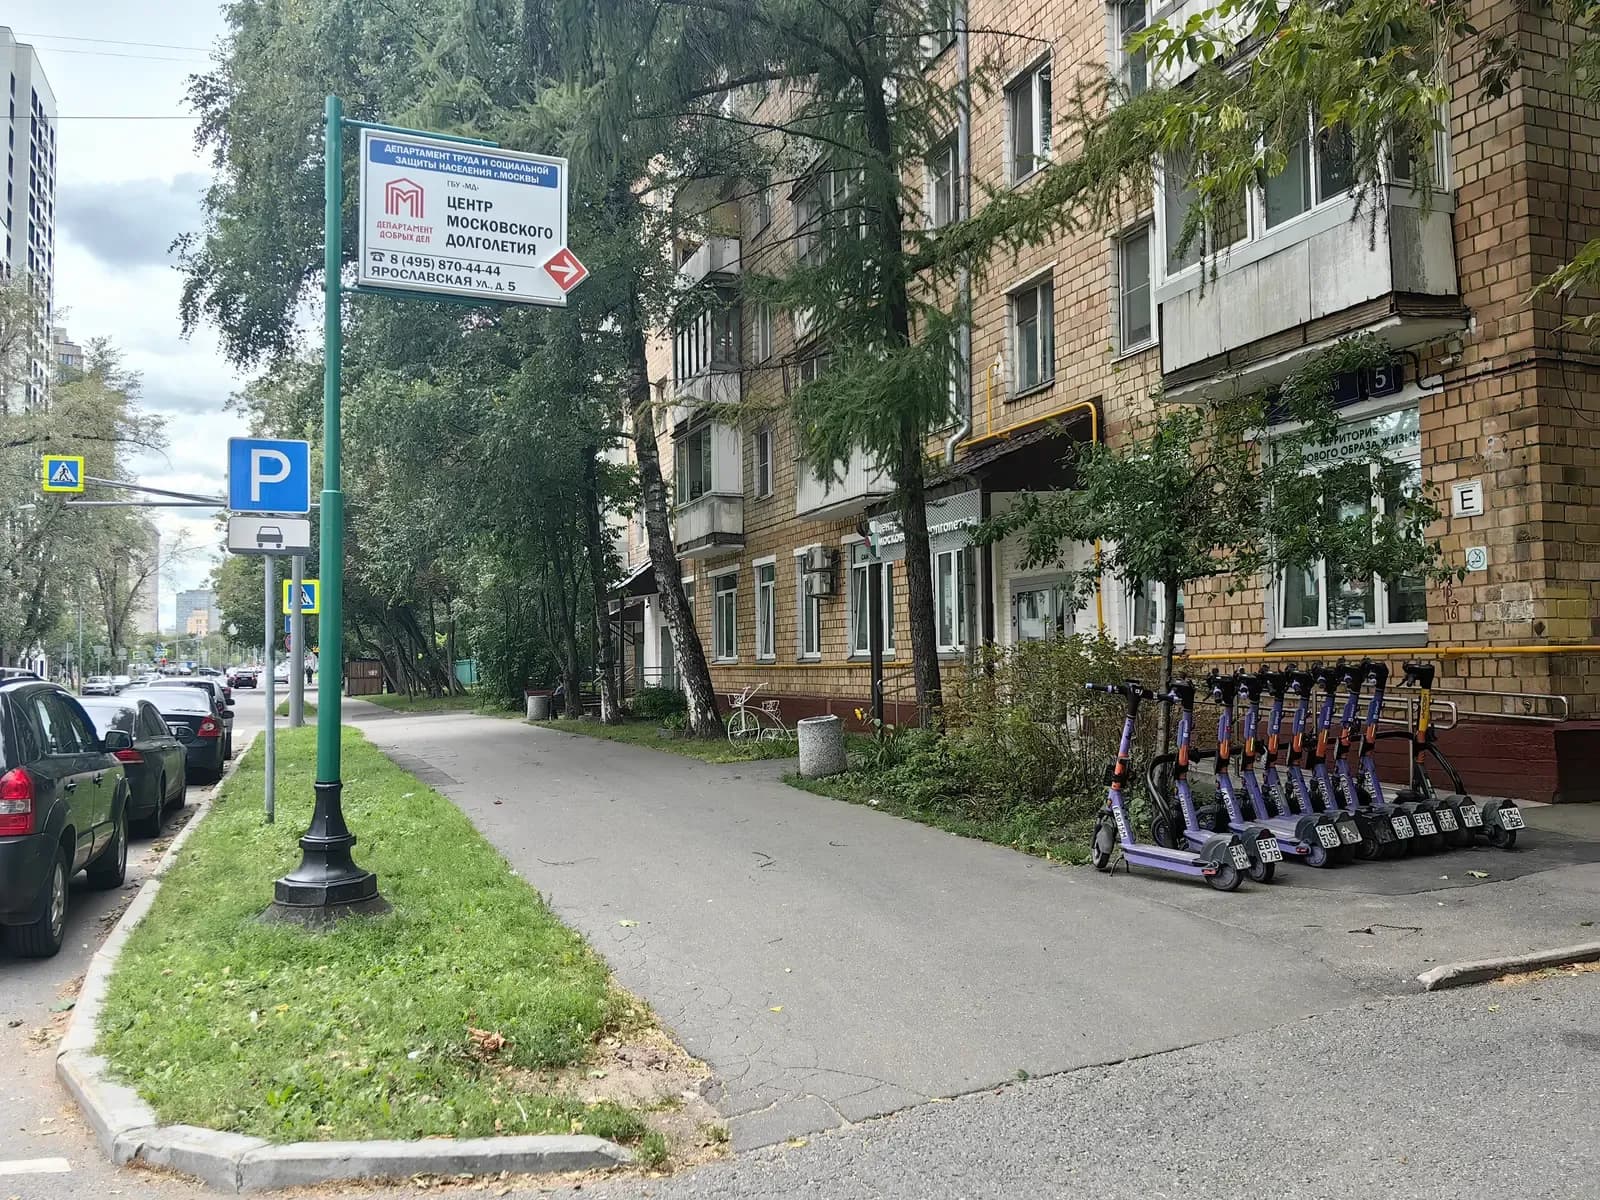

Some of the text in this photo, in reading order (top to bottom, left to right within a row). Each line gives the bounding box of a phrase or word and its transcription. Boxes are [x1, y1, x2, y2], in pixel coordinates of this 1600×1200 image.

[384, 144, 450, 160] ДЕПАРТАМЕНТ
[452, 154, 479, 165] ТРУДА
[490, 160, 549, 175] СОЦИАЛЬНОЙ
[395, 157, 437, 169] ЗАЩИТЫ
[439, 163, 492, 176] НАСЕЛЕНИЯ
[447, 196, 493, 213] ЦЕНТР
[376, 220, 433, 234] ДЕПАРТАМЕНТ
[379, 230, 431, 244] ДОБРЫХ ДЕЛ
[447, 215, 553, 239] МОСКОВСКОГО
[446, 233, 536, 255] ДОЛГОЛЕТИЯ
[390, 254, 501, 276] 8 (495) 870-44-44
[371, 266, 472, 287] ЯРОСЛАВСКАЯ
[508, 281, 516, 291] 5
[1375, 367, 1387, 389] 5
[1340, 441, 1377, 456] ОБРАЗА
[250, 448, 291, 502] P
[1446, 607, 1457, 620] 16
